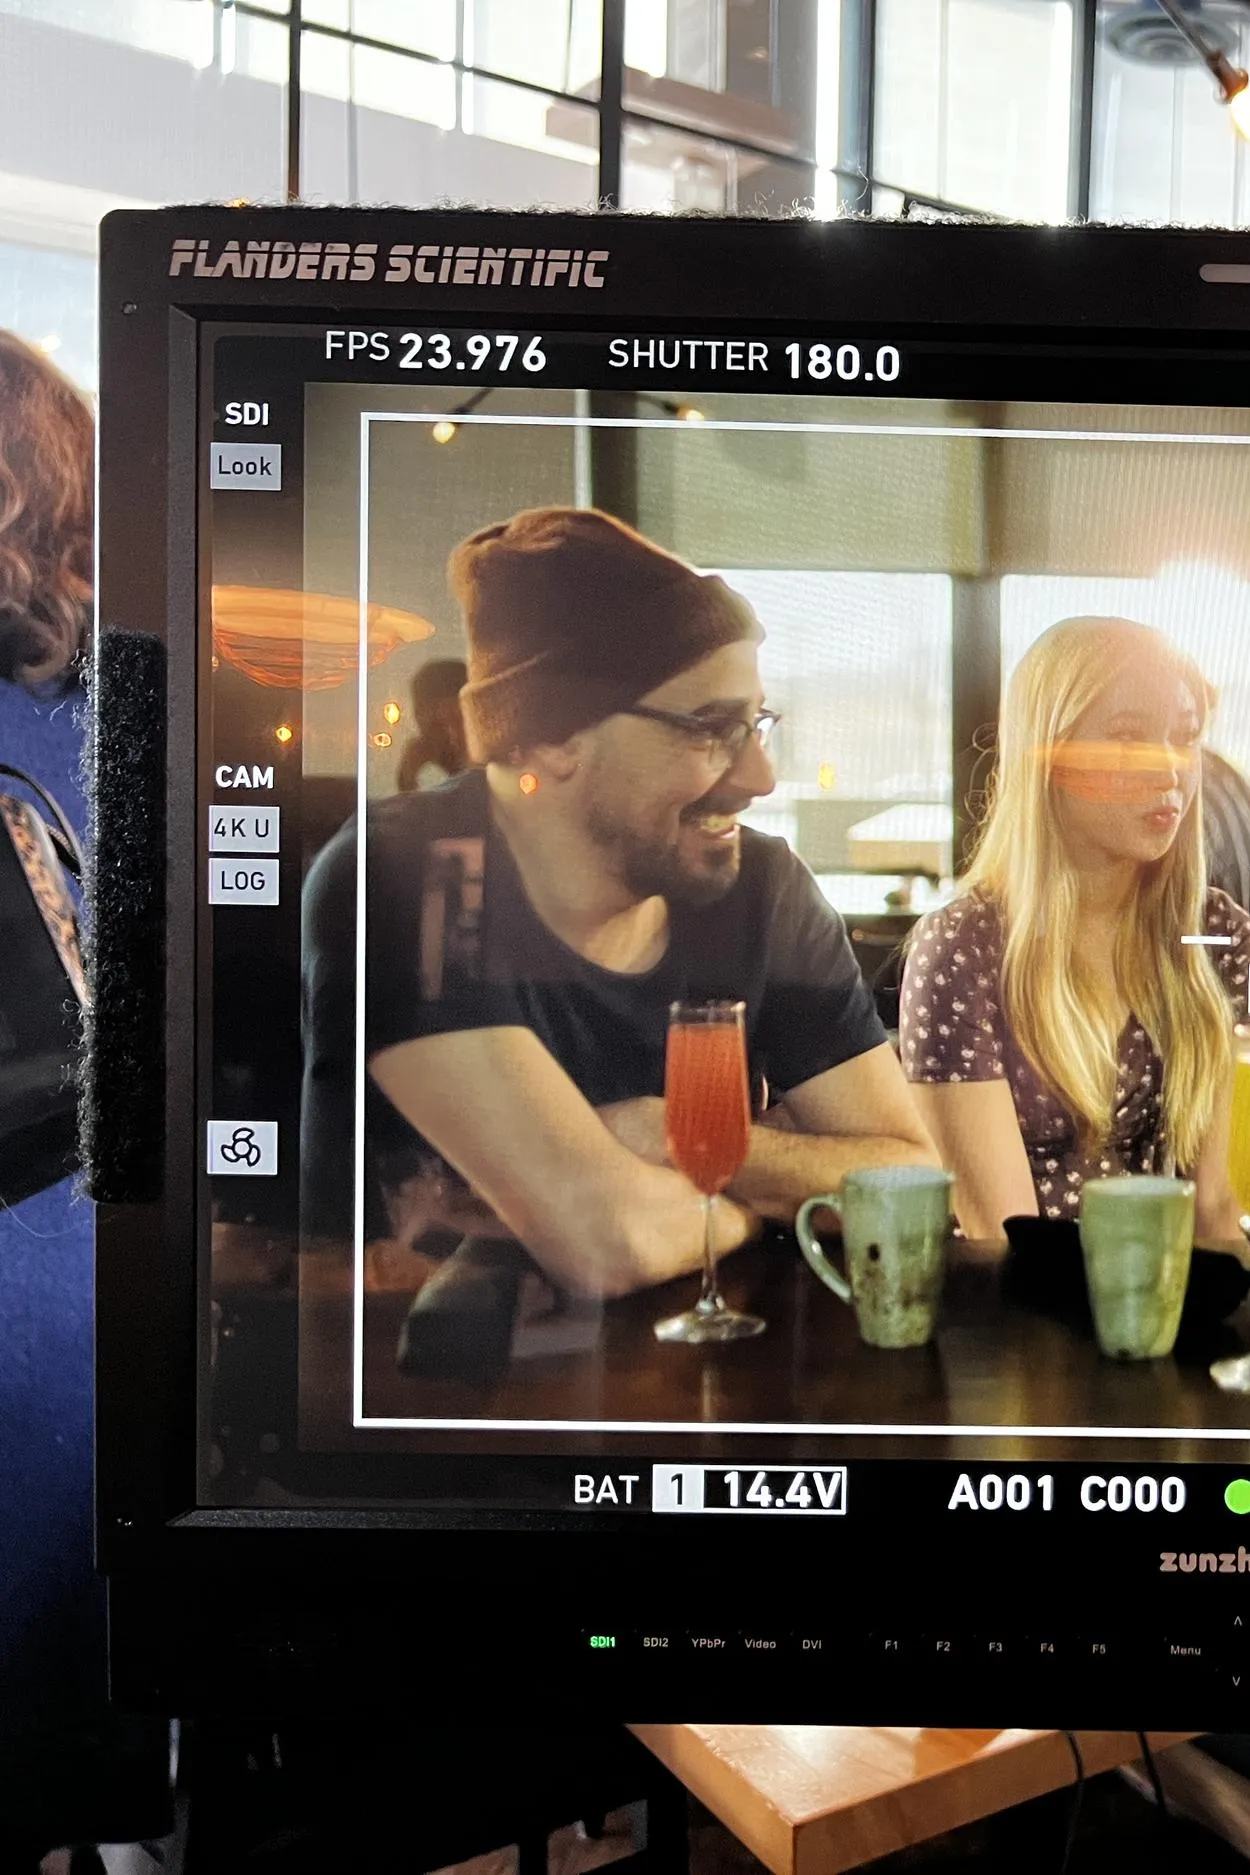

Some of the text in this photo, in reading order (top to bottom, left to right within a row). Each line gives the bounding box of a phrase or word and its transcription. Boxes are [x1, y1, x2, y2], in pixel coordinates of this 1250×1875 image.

[169, 239, 610, 288] FLANDERS SCIENTIFIC
[325, 330, 547, 372] FPS 23.976
[608, 338, 900, 382] SHUTTER 180.0
[224, 402, 269, 426] SDI
[218, 454, 272, 476] Look
[215, 765, 274, 789] CAM
[213, 817, 269, 838] 4K U
[221, 870, 266, 891] LOG
[574, 1471, 842, 1508] BAT 1 14.4V
[947, 1473, 1186, 1513] A001 C000
[589, 1635, 616, 1649] SDI1
[643, 1637, 669, 1648] SDI2
[691, 1638, 726, 1649] YPbPr
[744, 1638, 777, 1649] Video
[802, 1639, 822, 1649] DVI
[884, 1639, 898, 1650] F1
[936, 1641, 951, 1652] F2
[988, 1642, 1003, 1652] F3
[1040, 1642, 1054, 1653] F4
[1092, 1643, 1106, 1654] F5
[1170, 1644, 1201, 1655] Menu
